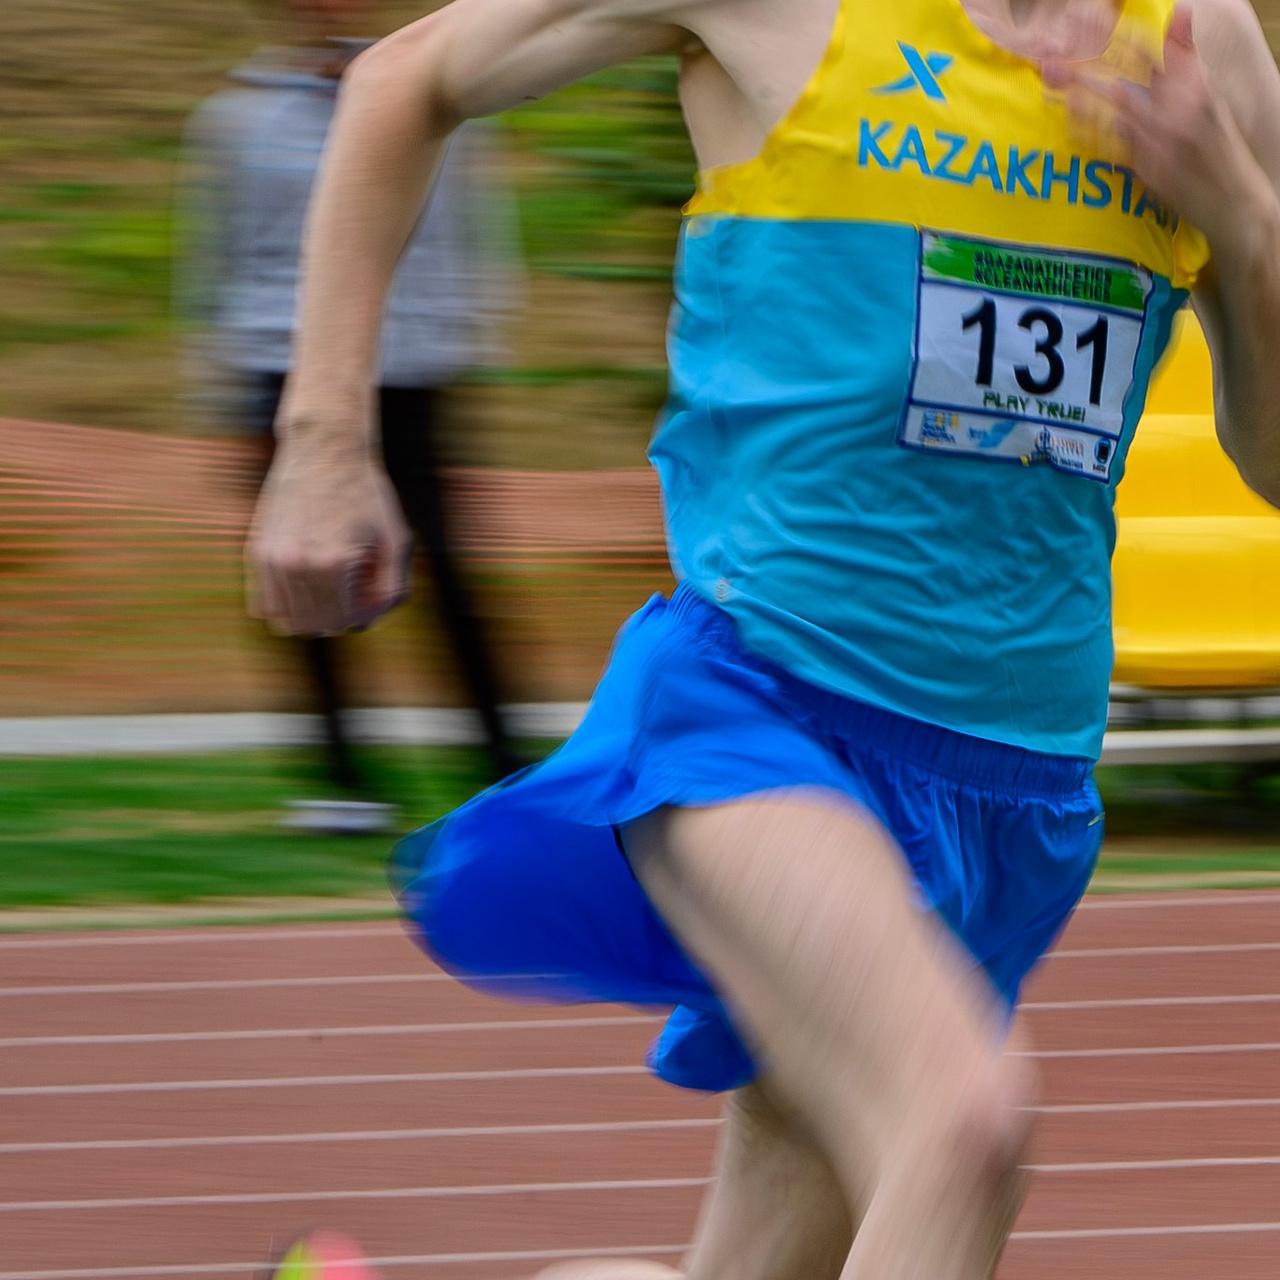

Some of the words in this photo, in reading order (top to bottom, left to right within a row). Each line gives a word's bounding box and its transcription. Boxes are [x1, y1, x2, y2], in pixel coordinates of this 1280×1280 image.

[961, 296, 1109, 406] 131
[983, 390, 1029, 413] PLAY
[1036, 398, 1086, 423] TRUE!
